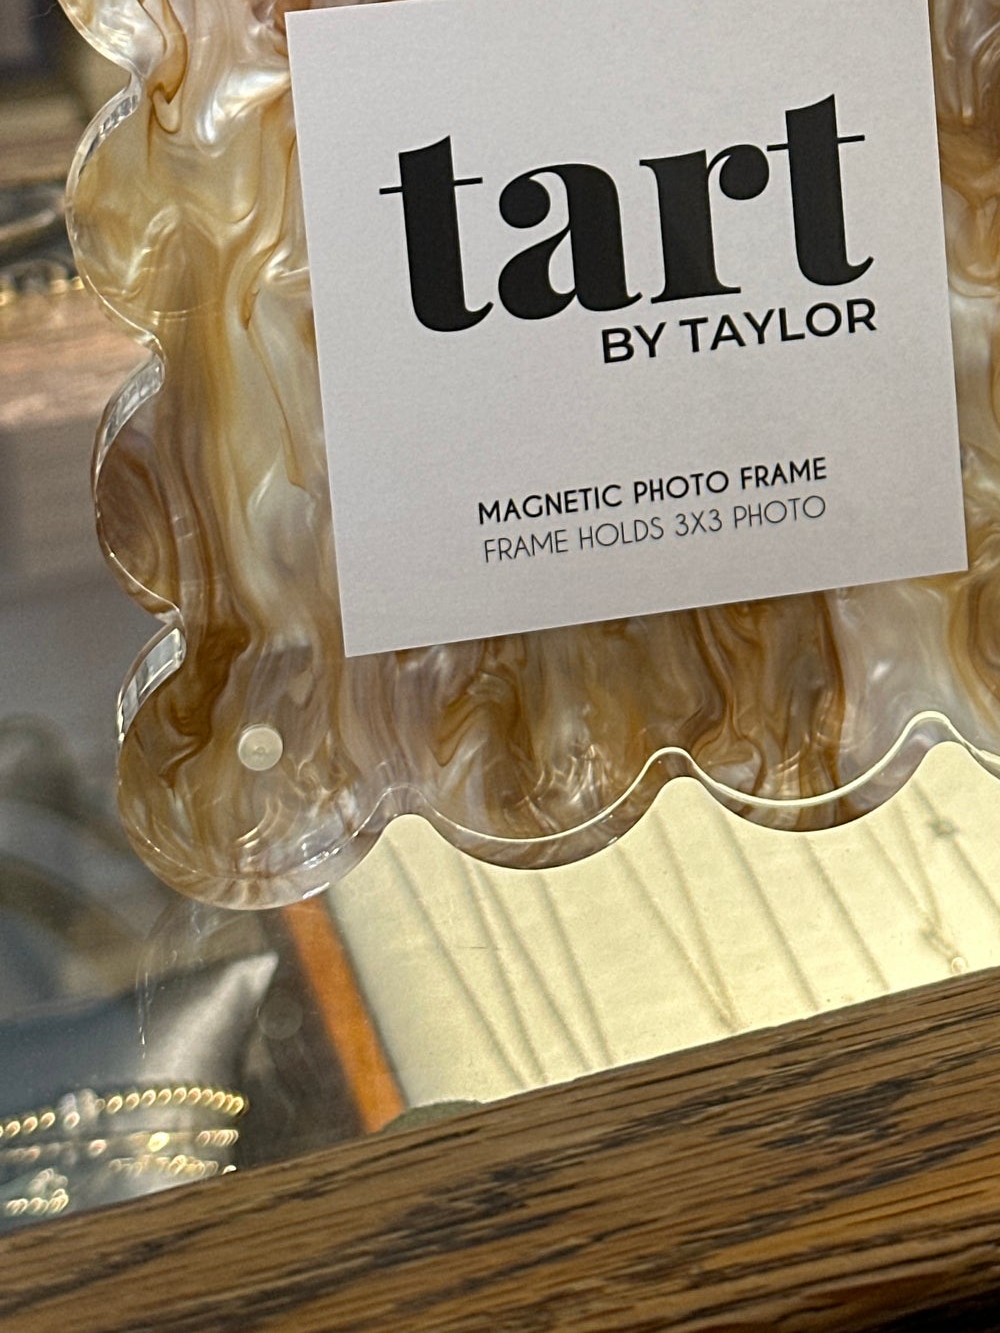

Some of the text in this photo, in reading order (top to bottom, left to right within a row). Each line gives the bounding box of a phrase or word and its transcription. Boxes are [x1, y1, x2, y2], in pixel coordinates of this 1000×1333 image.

[379, 93, 875, 333] tart
[601, 298, 878, 364] BY TAYLOR
[478, 457, 828, 525] MAGNETIC PHOTO FRAME
[483, 495, 826, 563] FRAME HOLDS 3X3 PHOTO
